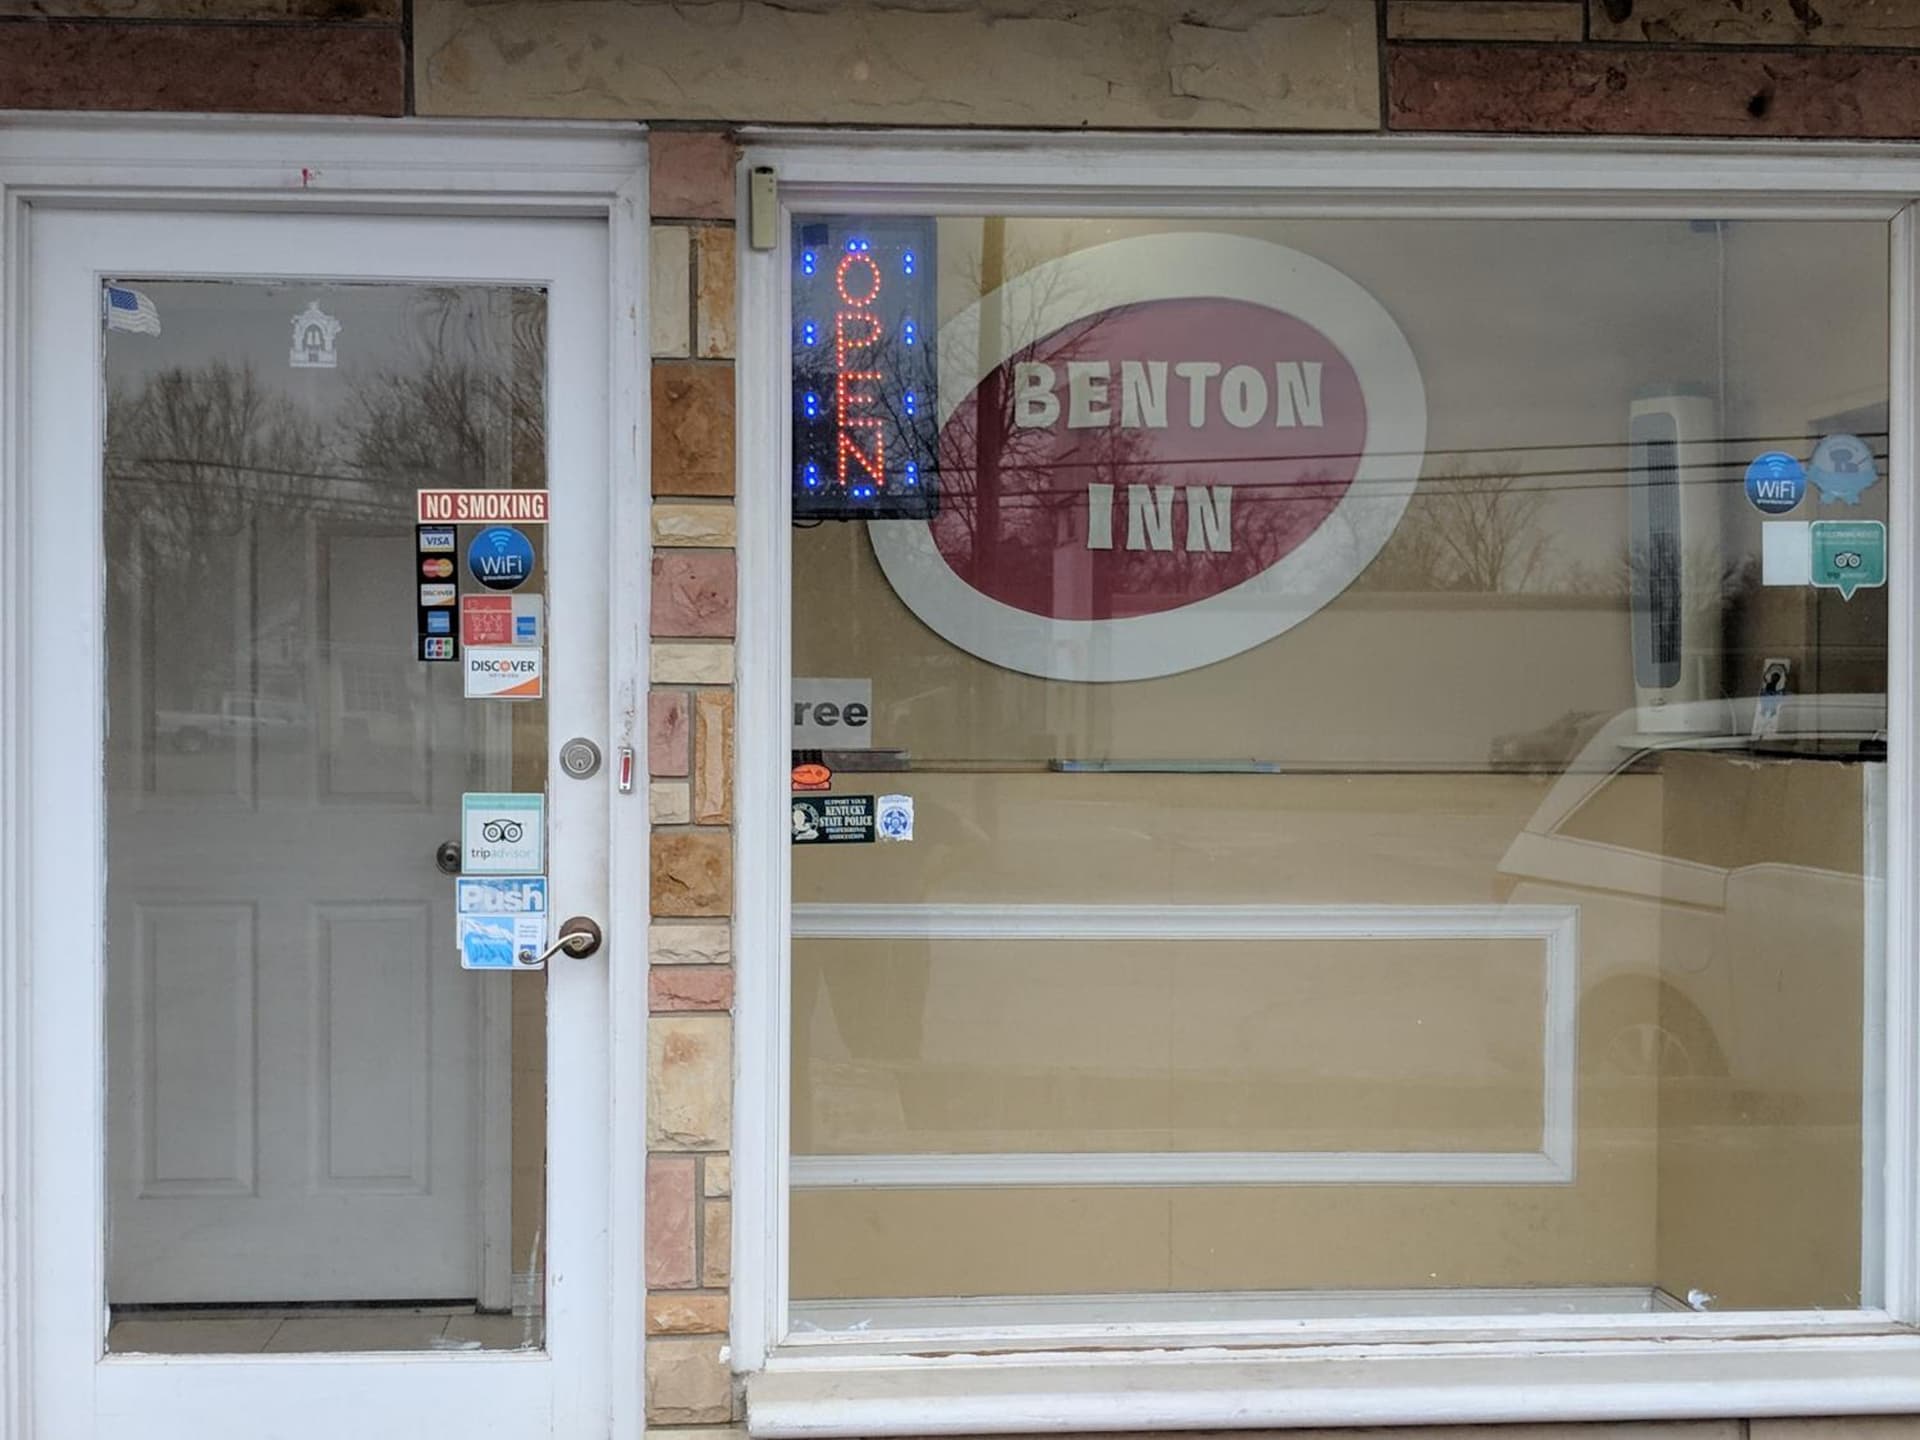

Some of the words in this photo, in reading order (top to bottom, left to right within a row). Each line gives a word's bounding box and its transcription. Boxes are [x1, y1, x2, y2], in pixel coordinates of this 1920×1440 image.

[836, 253, 885, 487] OPEN
[1014, 360, 1324, 429] BENTON
[1756, 479, 1796, 499] WiFi
[426, 494, 452, 519] NO
[457, 494, 545, 519] SMOKING
[1087, 482, 1234, 552] INN
[425, 536, 450, 546] VISA
[480, 555, 523, 575] WiFi
[471, 660, 536, 672] DISCOVER
[825, 805, 866, 816] KENTUCKY
[820, 816, 843, 827] STATE
[844, 815, 873, 827] POLICE
[460, 883, 543, 913] Push
